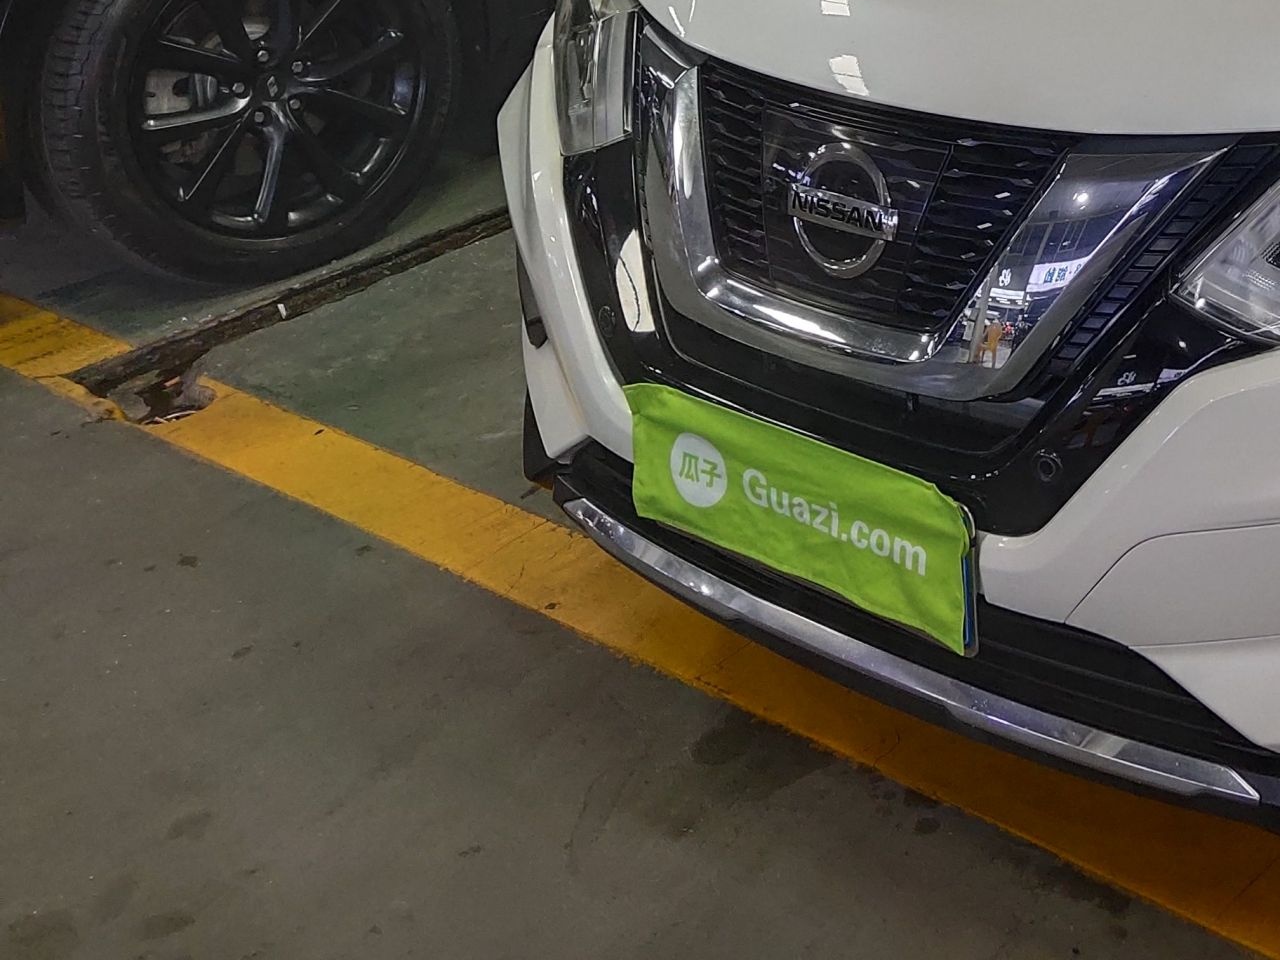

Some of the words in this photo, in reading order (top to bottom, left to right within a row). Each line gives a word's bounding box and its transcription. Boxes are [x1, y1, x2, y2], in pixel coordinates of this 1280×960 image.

[792, 190, 884, 231] NISSAN
[679, 451, 721, 488] 瓜子
[742, 468, 927, 577] Guazi.com
